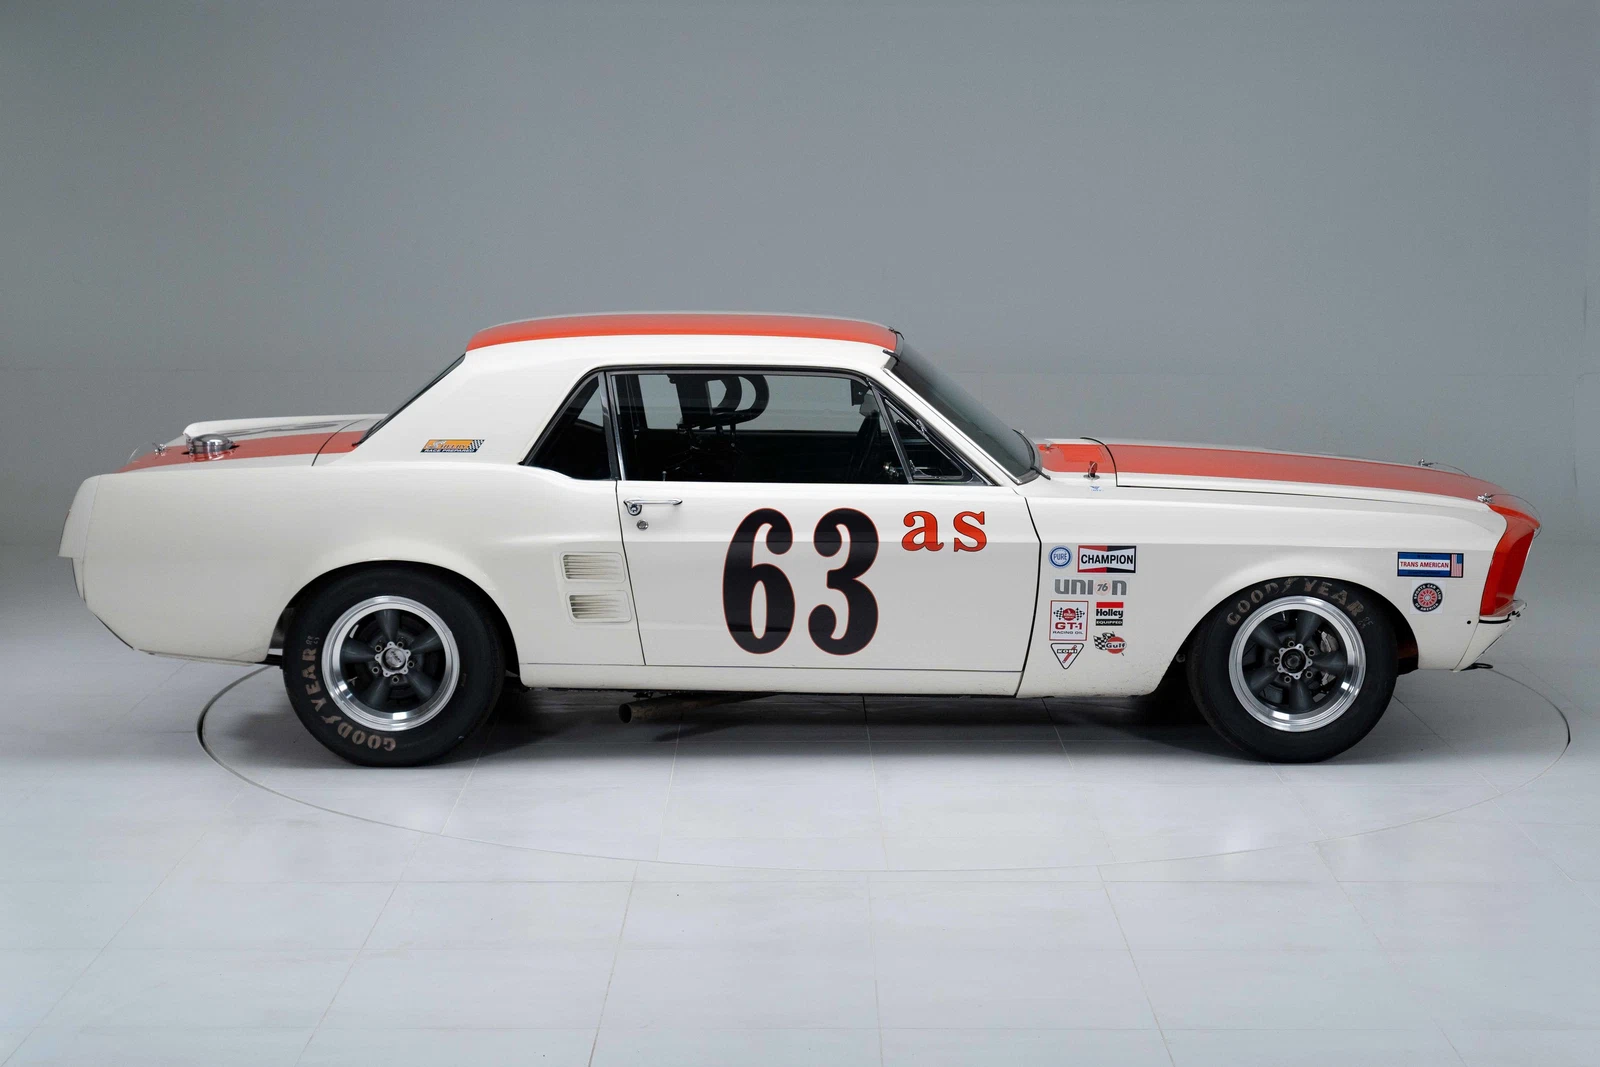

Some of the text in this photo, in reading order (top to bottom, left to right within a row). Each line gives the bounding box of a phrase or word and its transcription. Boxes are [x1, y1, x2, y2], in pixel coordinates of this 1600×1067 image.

[901, 510, 988, 552] as
[1053, 553, 1067, 561] PURE
[1080, 554, 1133, 564] CHAMPION
[722, 507, 879, 656] 63
[1413, 585, 1426, 600] SPORTS
[1226, 577, 1364, 626] GOODYEAR
[1095, 608, 1124, 619] Holley
[1055, 622, 1083, 630] GT-1
[302, 648, 397, 751] GOODYEAR
